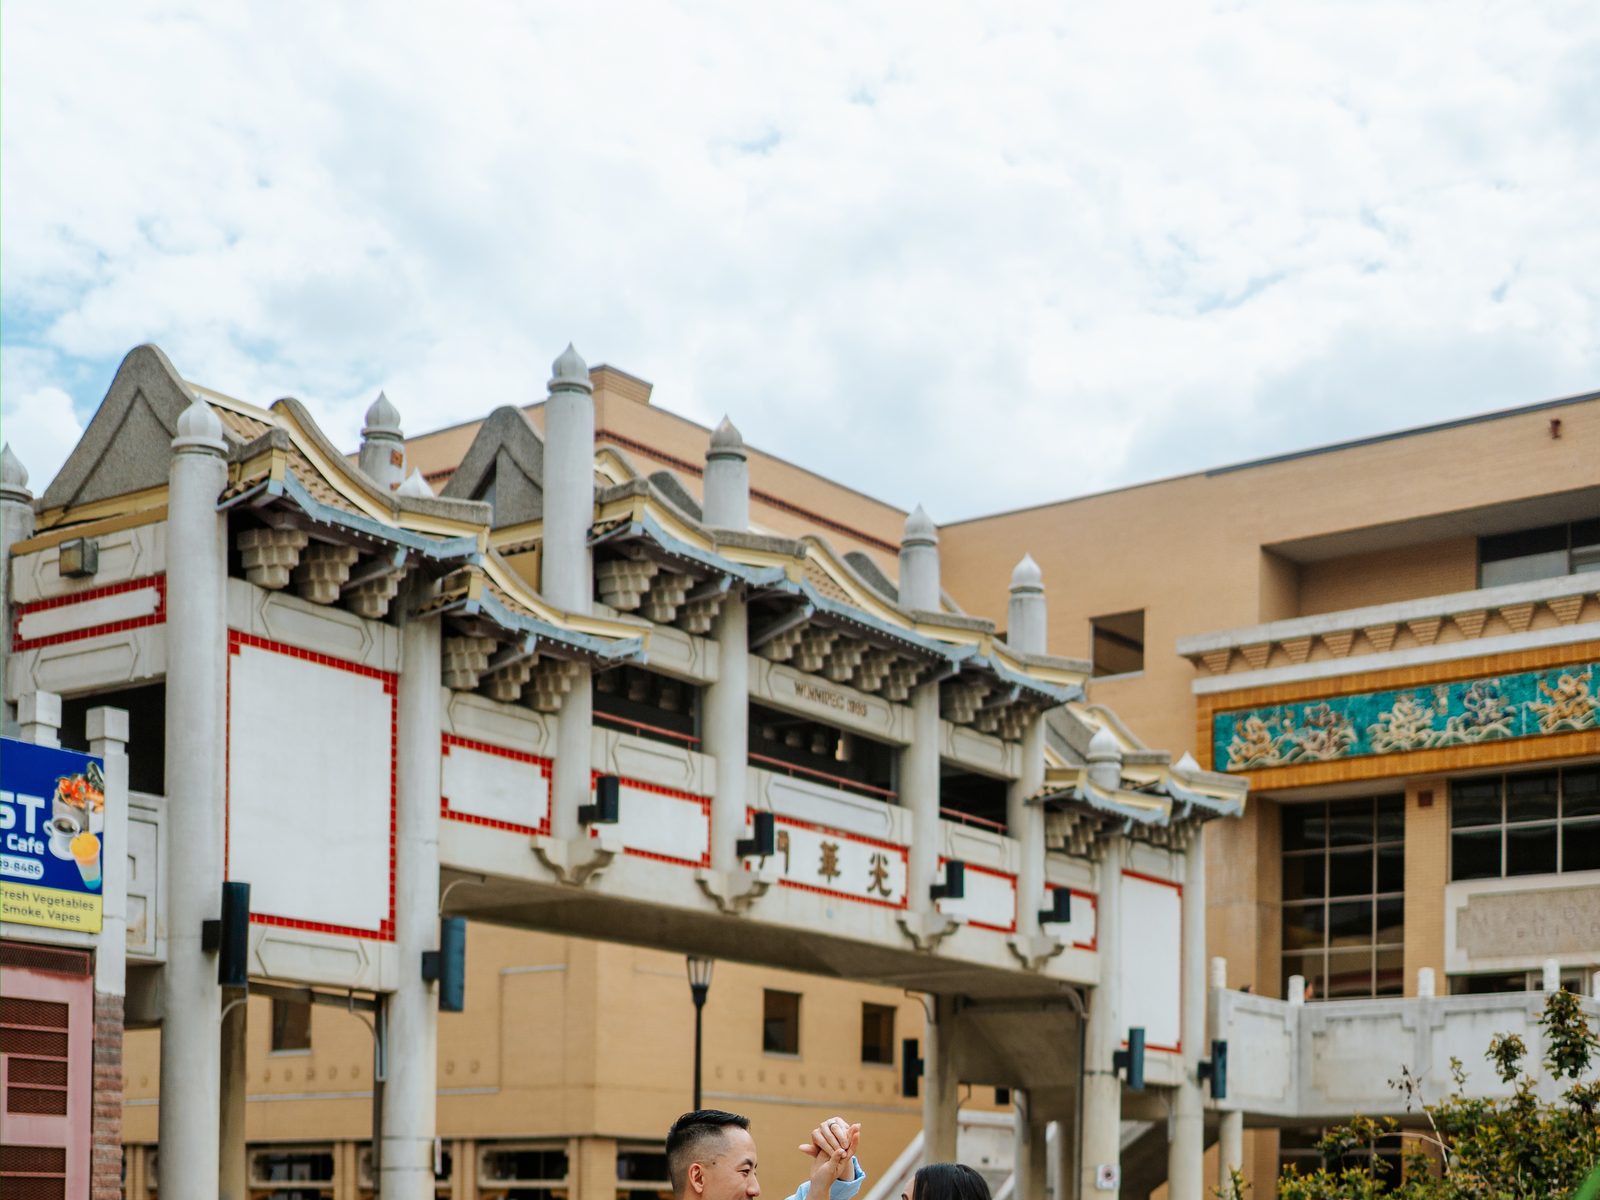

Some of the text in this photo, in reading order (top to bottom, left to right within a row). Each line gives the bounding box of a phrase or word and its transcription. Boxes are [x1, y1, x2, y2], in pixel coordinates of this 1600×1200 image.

[7, 833, 45, 855] Cafe
[32, 892, 94, 911] Vegetables
[2, 903, 81, 924] Smoke, Vapes
